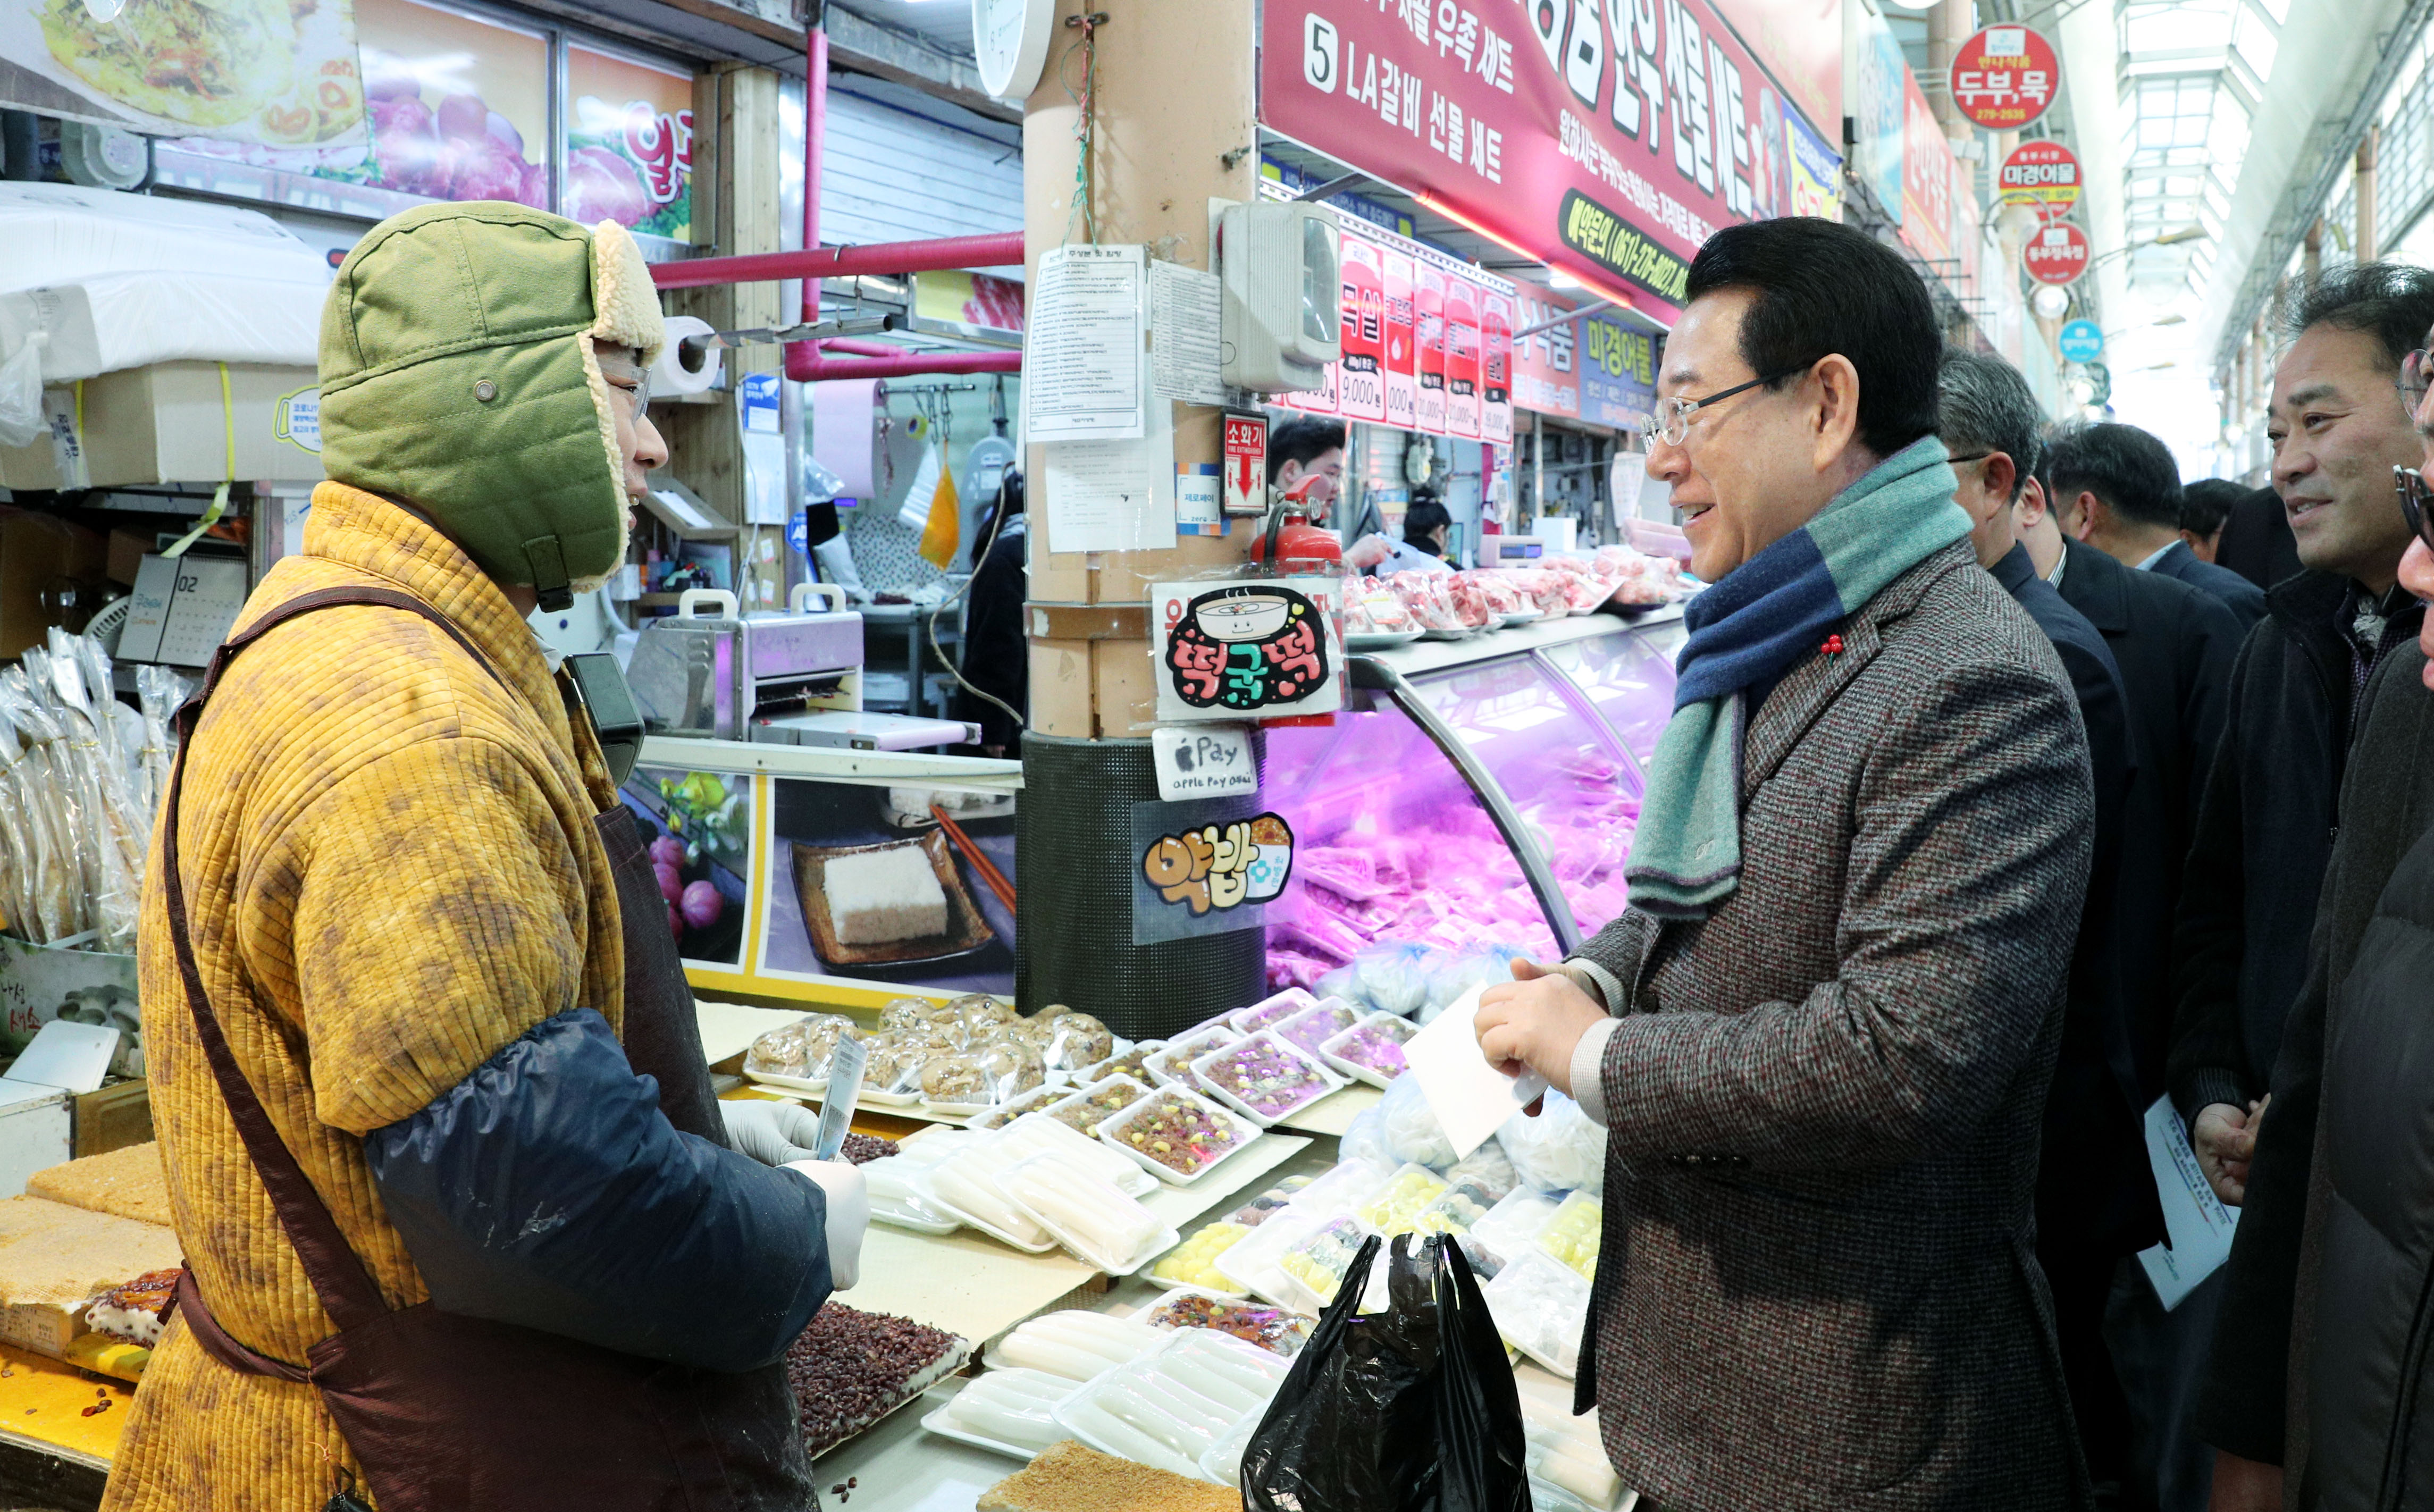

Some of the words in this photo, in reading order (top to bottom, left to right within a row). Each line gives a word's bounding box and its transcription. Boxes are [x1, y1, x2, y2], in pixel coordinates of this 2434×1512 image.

[1434, 0, 1479, 73] 우족
[1476, 26, 1514, 95] 세트
[1955, 70, 2050, 107] 두부,묵
[1346, 41, 1422, 138] LA갈비
[1429, 90, 1464, 165] 선물
[1469, 117, 1503, 185] 세트
[2004, 163, 2076, 186] 미경어물
[1568, 197, 1615, 259] 예약문의
[1588, 318, 1653, 387] 미경어물
[1342, 375, 1374, 406] 9,000
[1228, 424, 1263, 448] 소화기
[1239, 446, 1262, 455] EXTINGUISHER
[1185, 493, 1214, 502] 제로페이
[178, 576, 198, 592] 02
[1173, 619, 1320, 700] 떡국떡
[1197, 736, 1237, 767] Pay
[1145, 822, 1260, 913] 약밥
